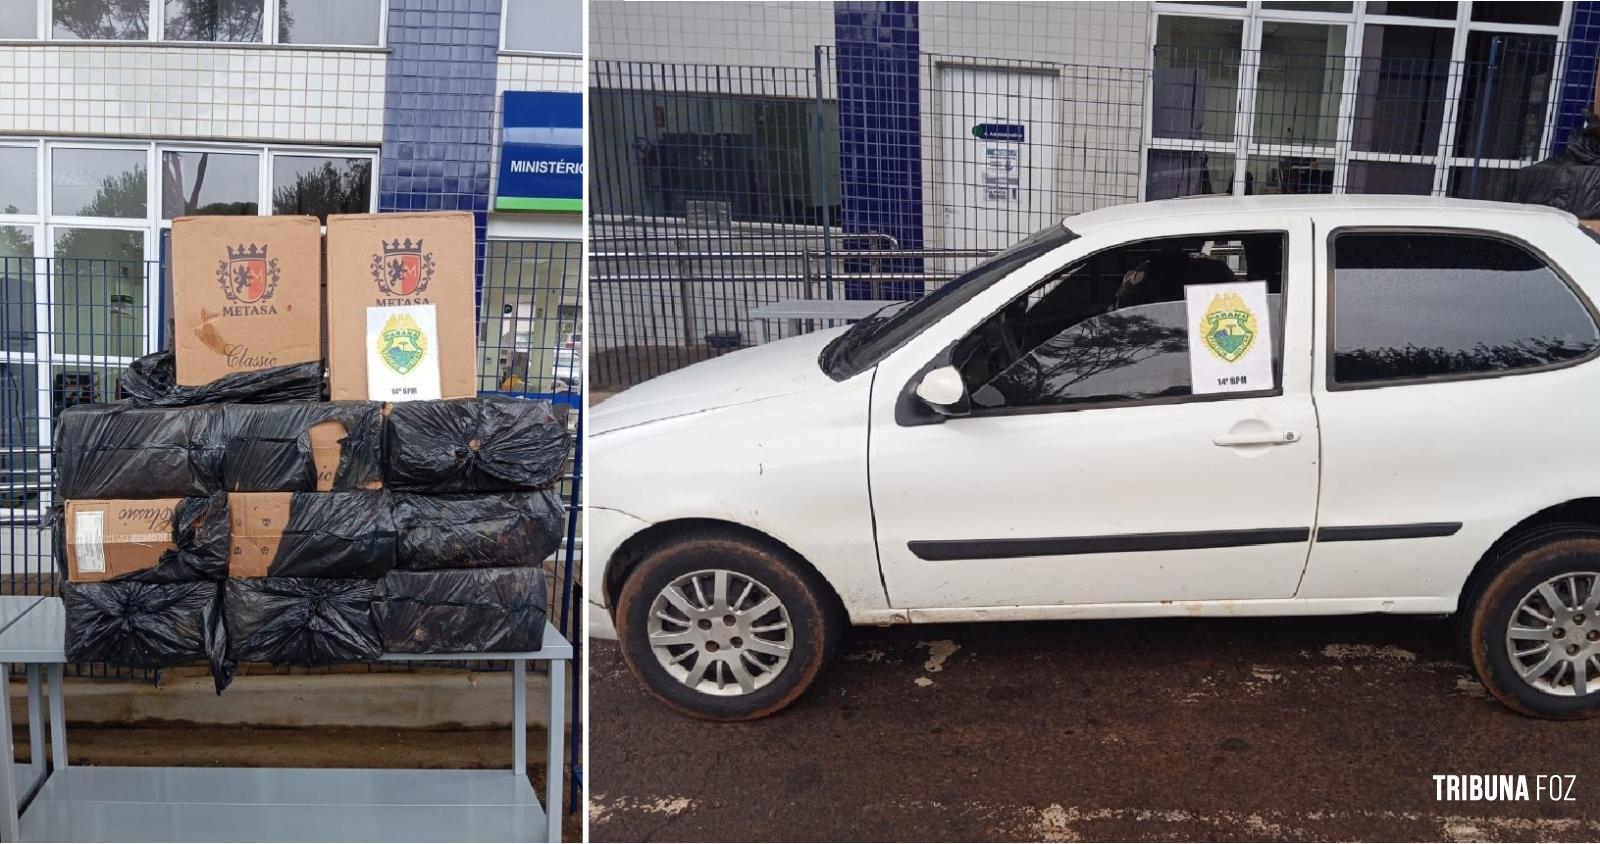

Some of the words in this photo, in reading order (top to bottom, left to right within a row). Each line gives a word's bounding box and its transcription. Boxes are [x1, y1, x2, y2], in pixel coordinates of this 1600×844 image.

[376, 298, 430, 306] METASA
[223, 305, 277, 317] METASA
[224, 343, 277, 368] Classic
[1230, 376, 1247, 385] BPM
[118, 506, 174, 533] Classic
